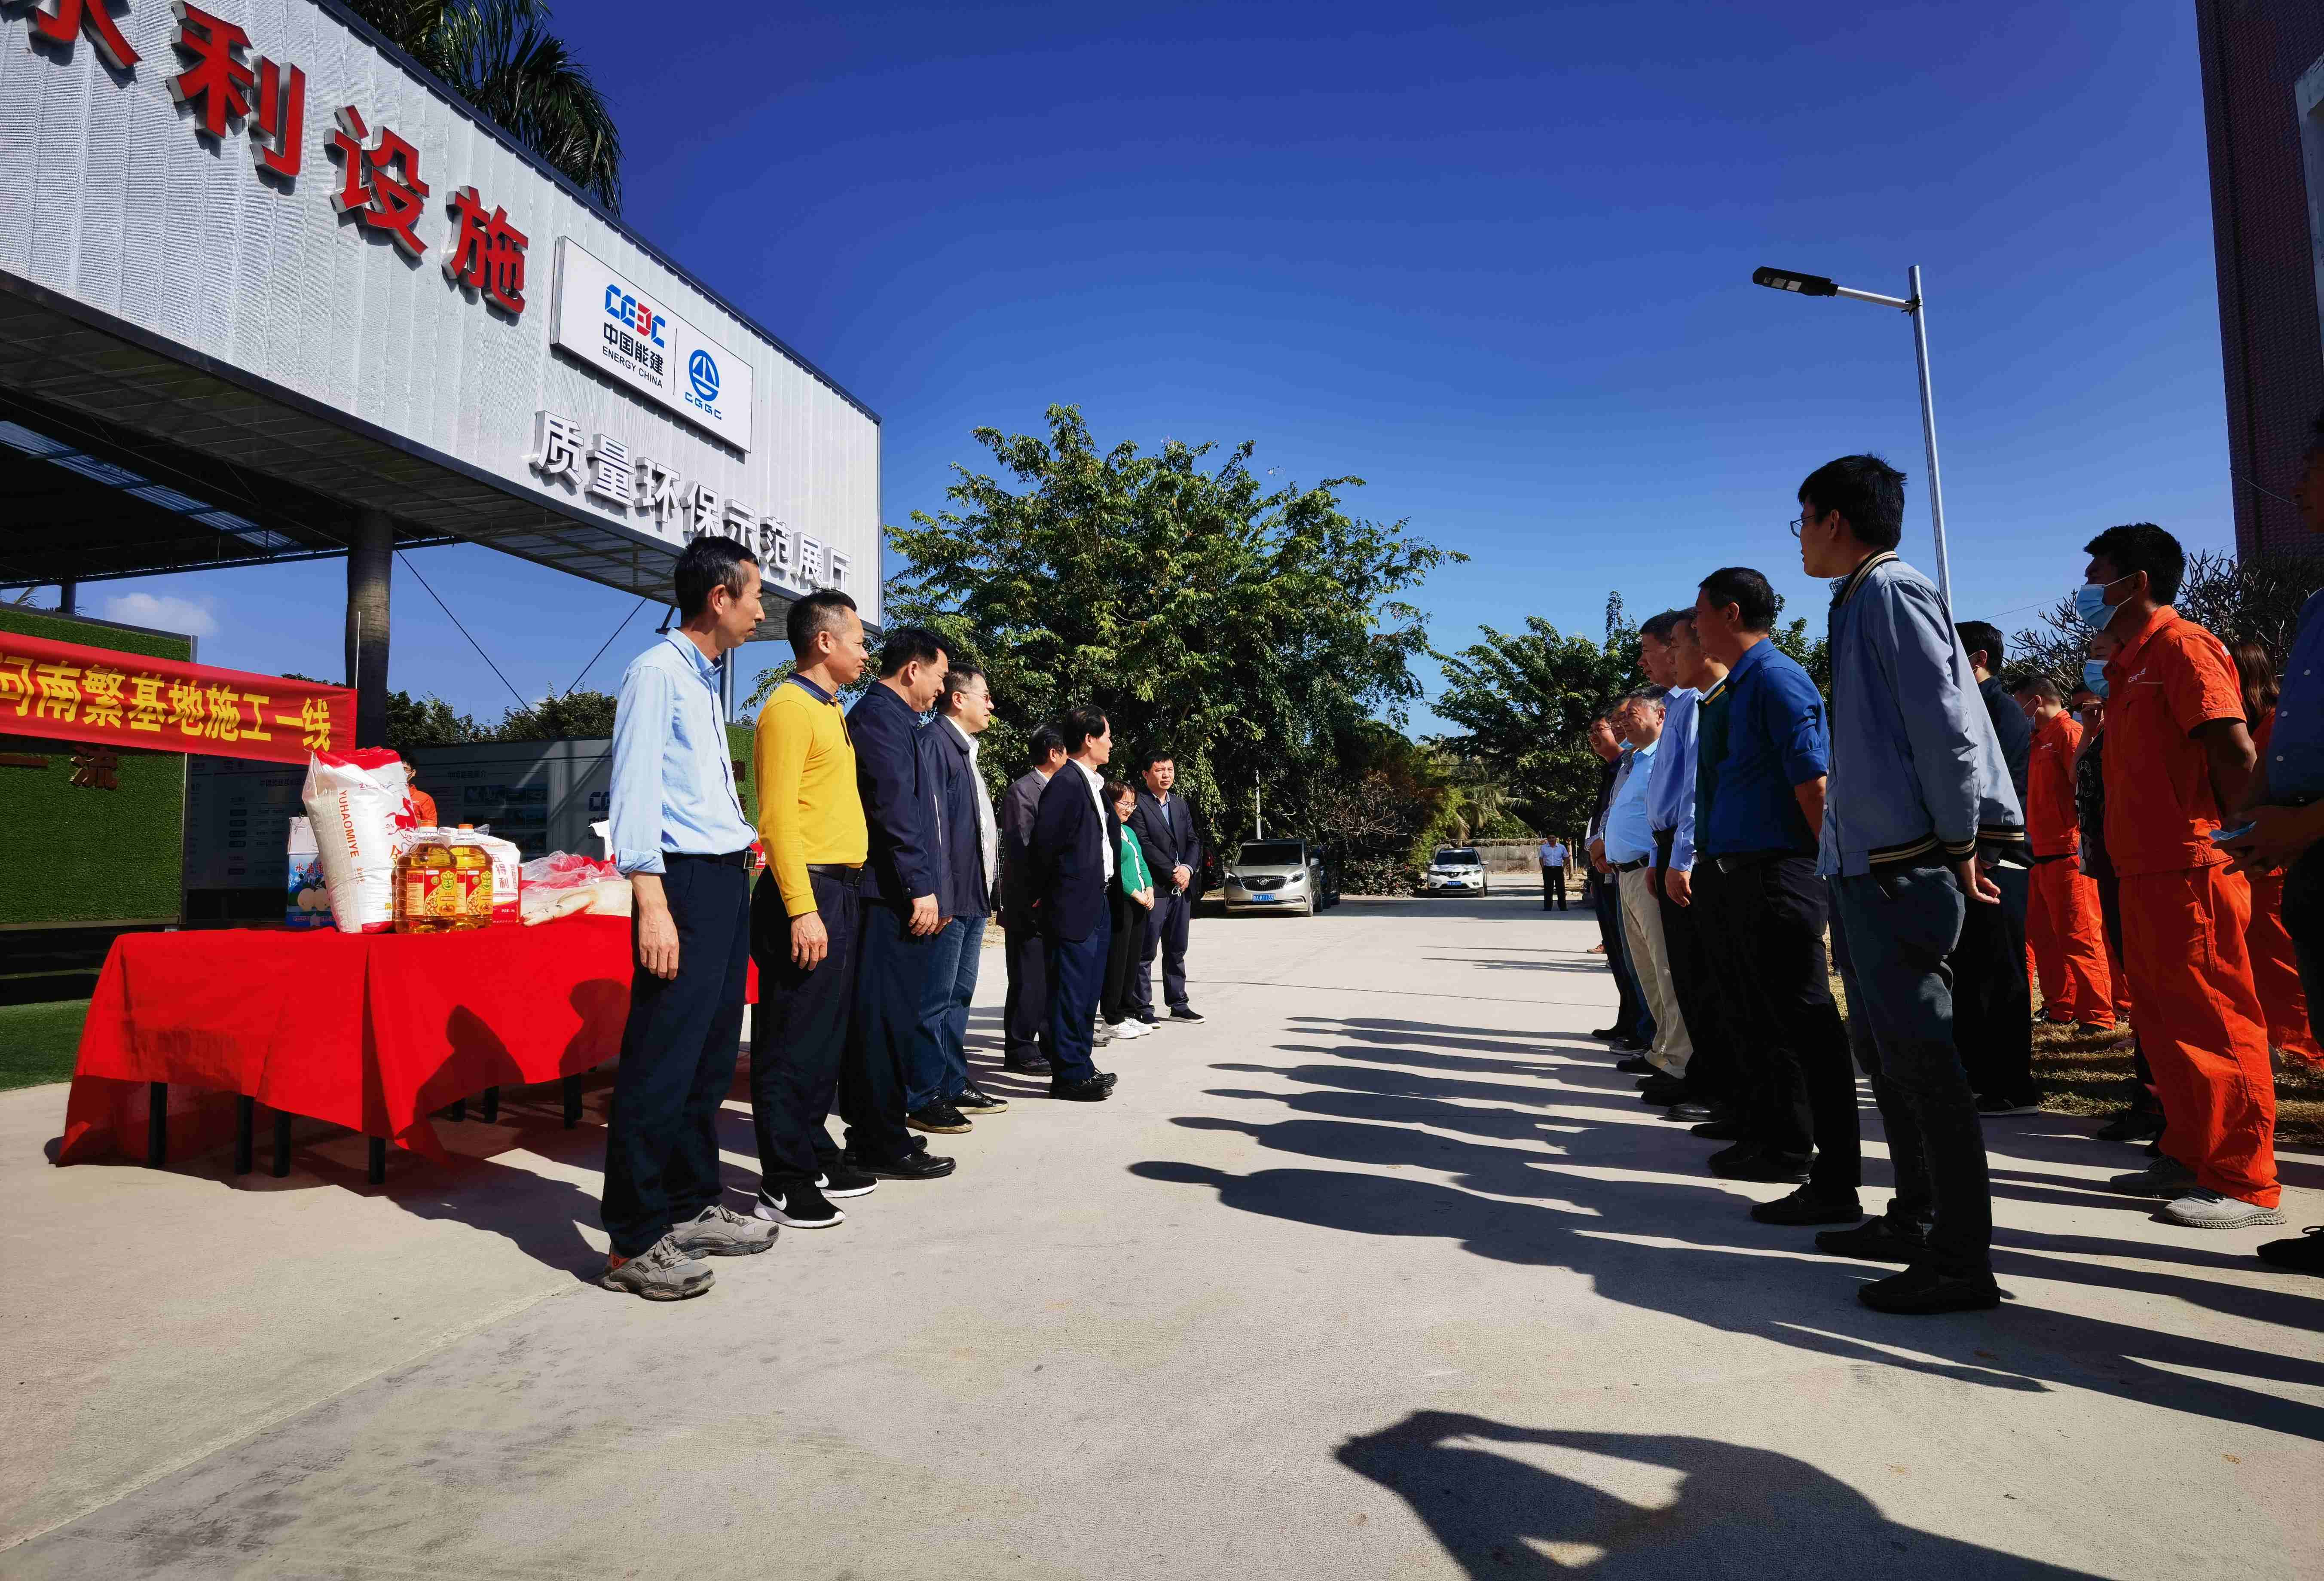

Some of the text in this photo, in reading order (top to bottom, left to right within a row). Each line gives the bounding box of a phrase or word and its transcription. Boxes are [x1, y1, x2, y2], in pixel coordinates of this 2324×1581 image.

[602, 345, 663, 388] ENERGY CHINA
[603, 322, 664, 376] 中国能建
[685, 392, 722, 420] CGGC
[534, 410, 851, 591] 质量环保示范展厅
[0, 652, 331, 752] 问南繁基地施工一线
[339, 790, 360, 858] YUHAOMIYE
[489, 854, 509, 889] 五得利
